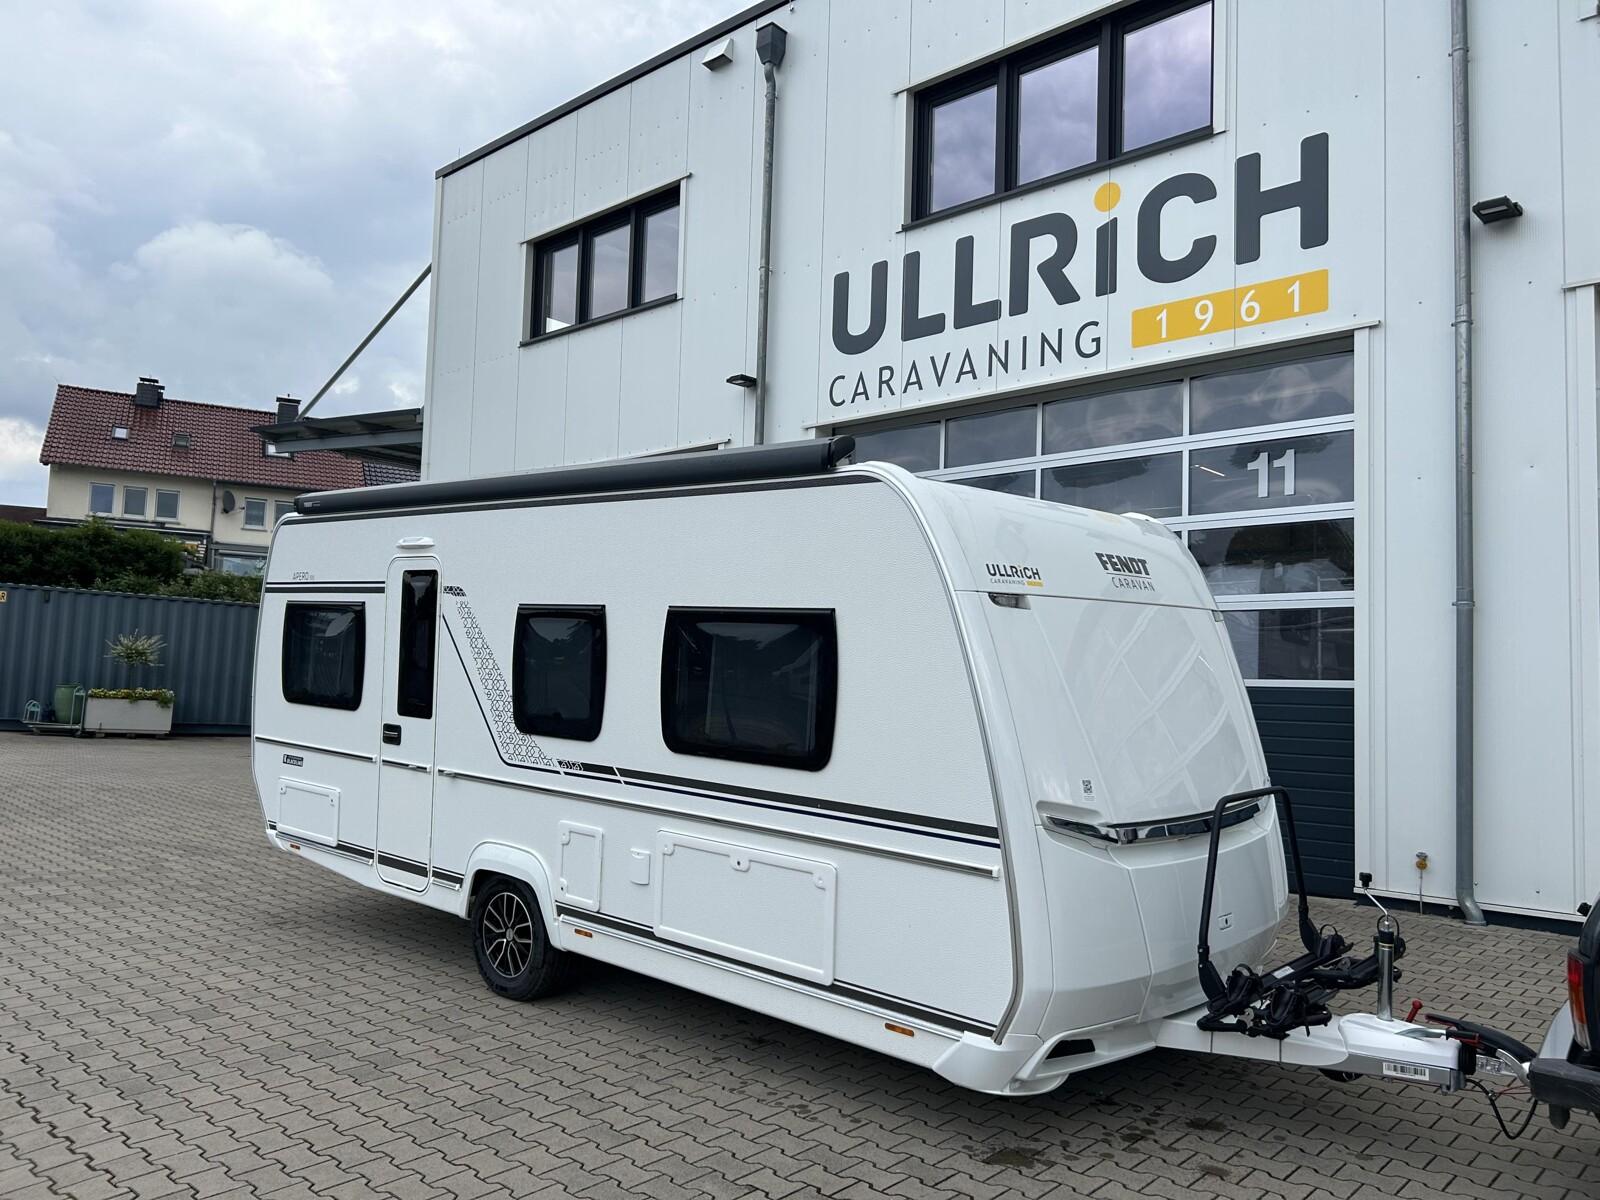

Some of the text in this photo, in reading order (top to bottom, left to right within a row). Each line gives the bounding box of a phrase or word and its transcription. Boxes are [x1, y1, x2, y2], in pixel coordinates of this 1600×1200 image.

[829, 321, 1101, 408] CARAVANING
[1247, 448, 1295, 498] 11
[1095, 552, 1150, 576] FENDT
[1111, 577, 1155, 592] CARAVAN
